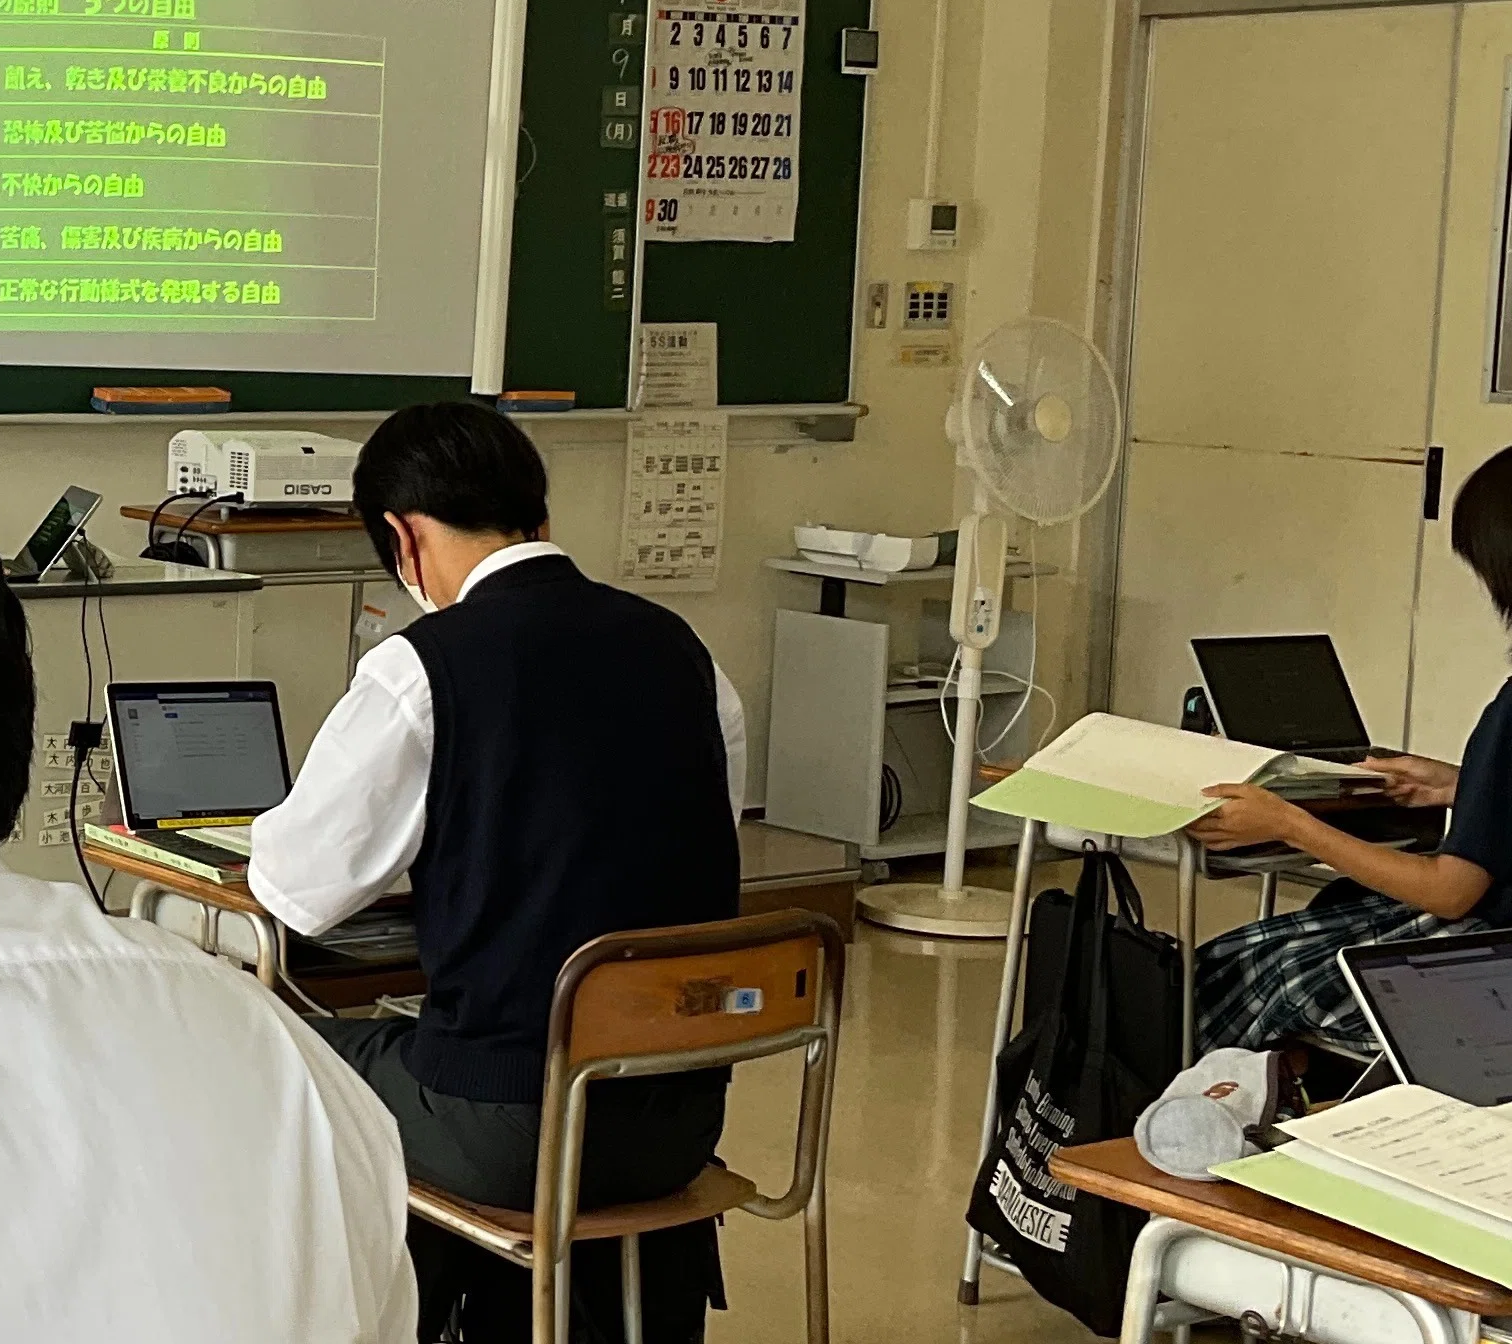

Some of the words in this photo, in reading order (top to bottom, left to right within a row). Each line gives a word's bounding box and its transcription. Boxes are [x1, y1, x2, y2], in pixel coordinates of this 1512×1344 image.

[670, 22, 681, 46] 2
[693, 23, 704, 47] 3
[715, 24, 726, 48] 4
[737, 25, 748, 48] 5
[760, 26, 770, 49] 6
[782, 26, 792, 50] 7
[612, 47, 630, 79] 9
[669, 66, 679, 90] 9
[688, 67, 706, 91] 10
[713, 68, 728, 91] 11
[734, 69, 750, 92] 12
[756, 69, 772, 93] 13
[778, 70, 794, 93] 14
[615, 91, 627, 108] 日
[2, 118, 227, 149] 恐怖及び苦悩からの自由
[663, 111, 681, 135] 16
[687, 111, 704, 135] 17
[709, 112, 726, 136] 18
[732, 113, 748, 136] 19
[751, 113, 771, 137] 20
[774, 113, 792, 138] 21
[661, 155, 680, 179] 23
[683, 155, 703, 179] 24
[706, 155, 725, 179] 25
[729, 156, 748, 179] 26
[751, 157, 769, 180] 27
[773, 157, 791, 180] 28
[1, 172, 145, 199] 不快からの自由
[658, 198, 678, 222] 30
[0, 225, 283, 253] 苦痛、傷害及び疾病からの自由
[284, 484, 332, 496] CASIO
